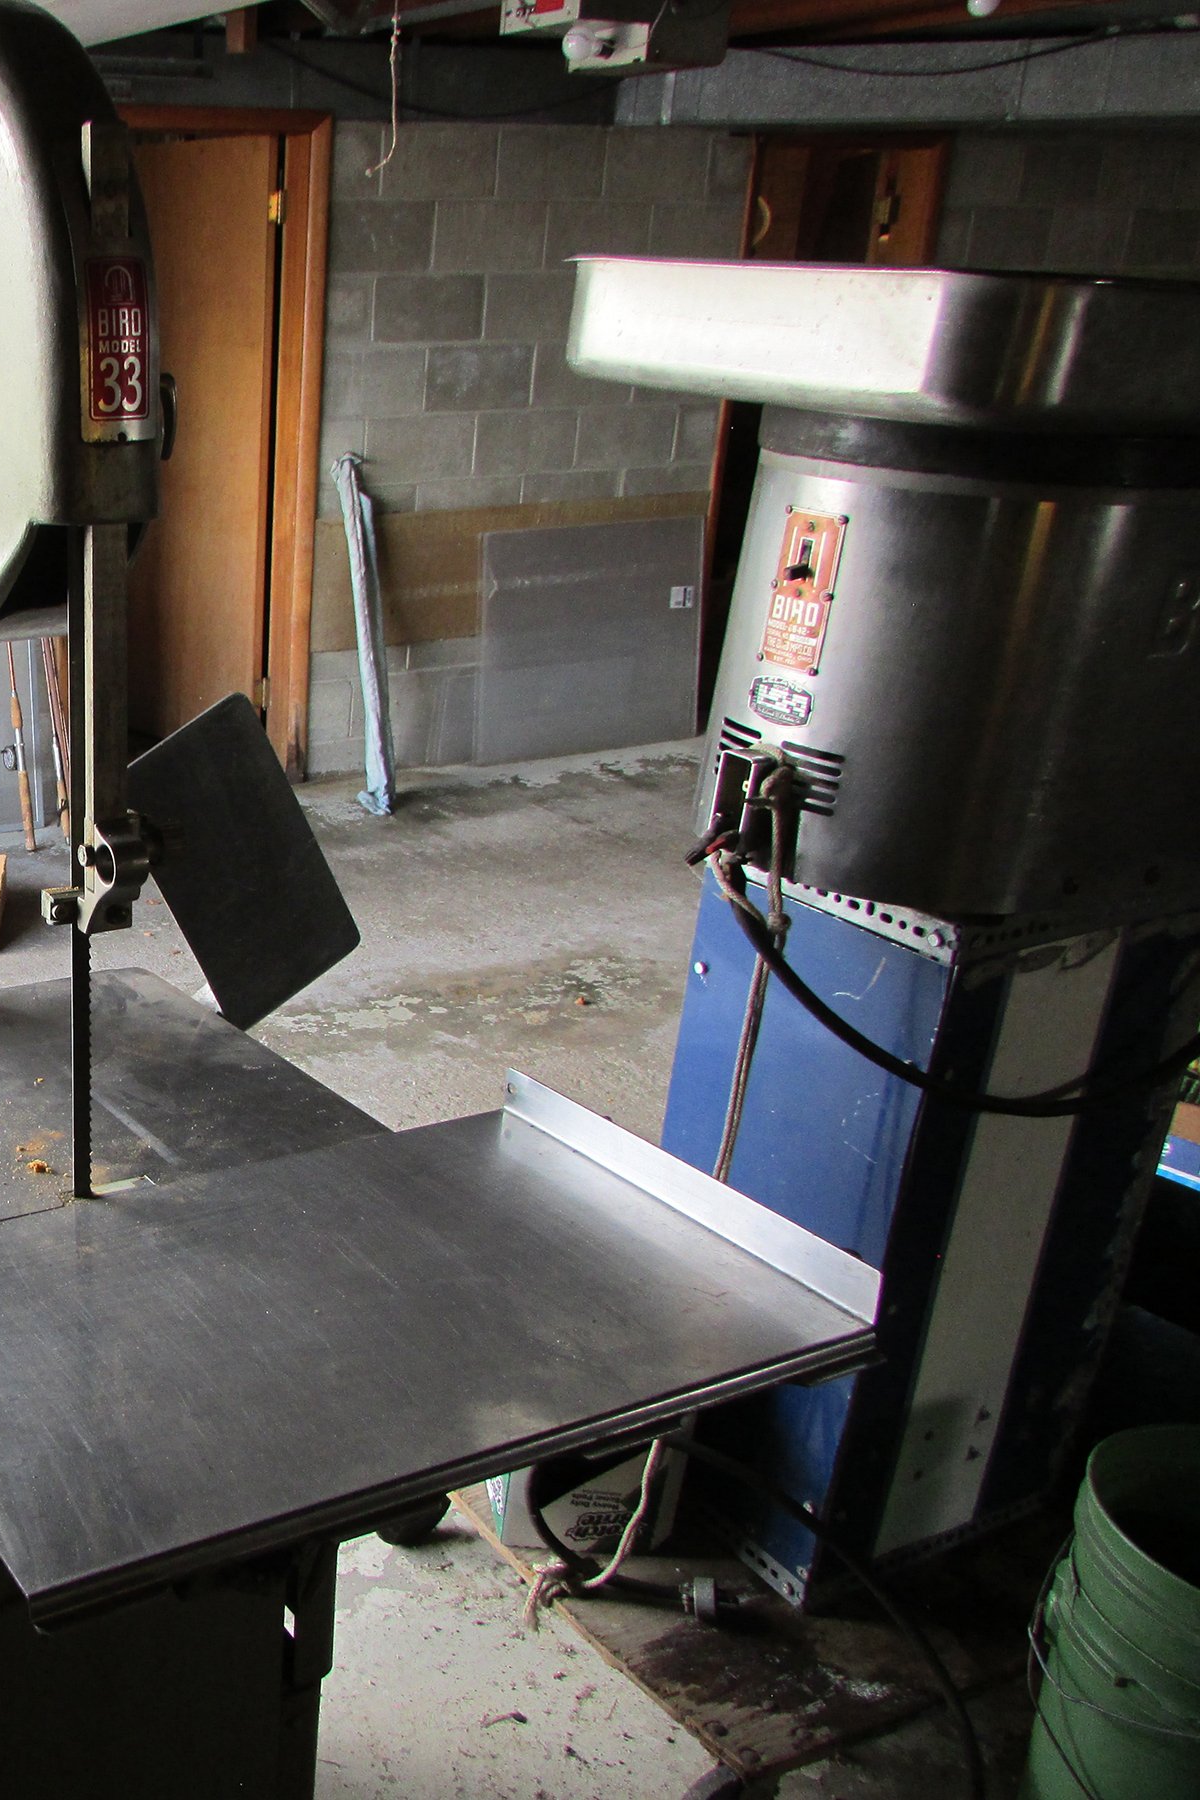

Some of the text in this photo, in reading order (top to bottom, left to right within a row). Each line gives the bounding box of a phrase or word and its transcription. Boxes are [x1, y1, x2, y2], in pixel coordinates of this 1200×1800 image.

[98, 308, 142, 337] BIRO
[99, 339, 142, 354] MODEL
[98, 356, 143, 413] 33
[771, 594, 819, 627] BIRO
